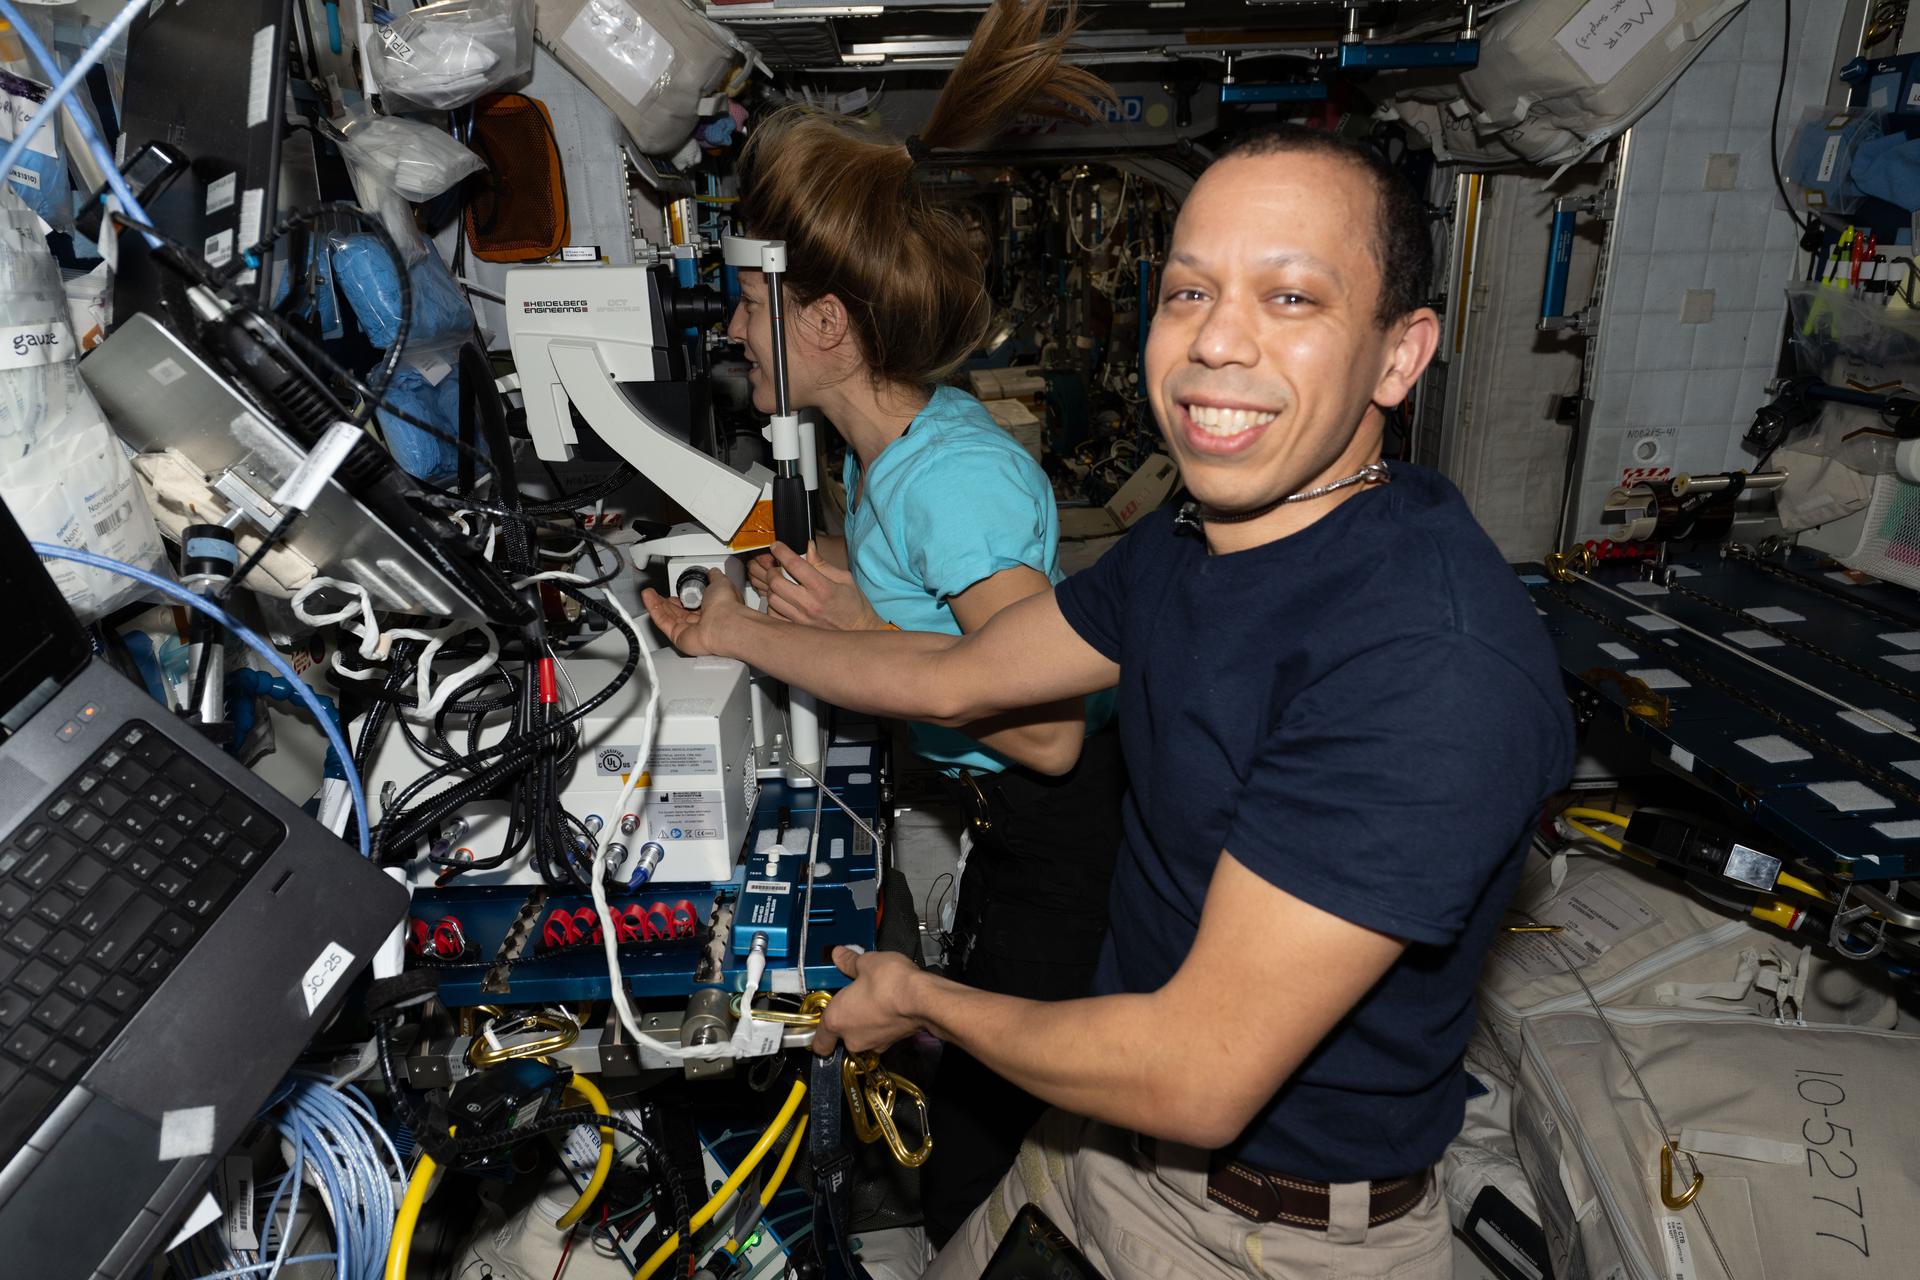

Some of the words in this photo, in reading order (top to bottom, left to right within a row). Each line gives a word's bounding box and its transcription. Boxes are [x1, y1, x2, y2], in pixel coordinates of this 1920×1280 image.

[1602, 0, 1654, 50] MEIR
[13, 332, 59, 356] gauze
[850, 1087, 861, 1113] CAMP
[1677, 1231, 1686, 1244] CTB
